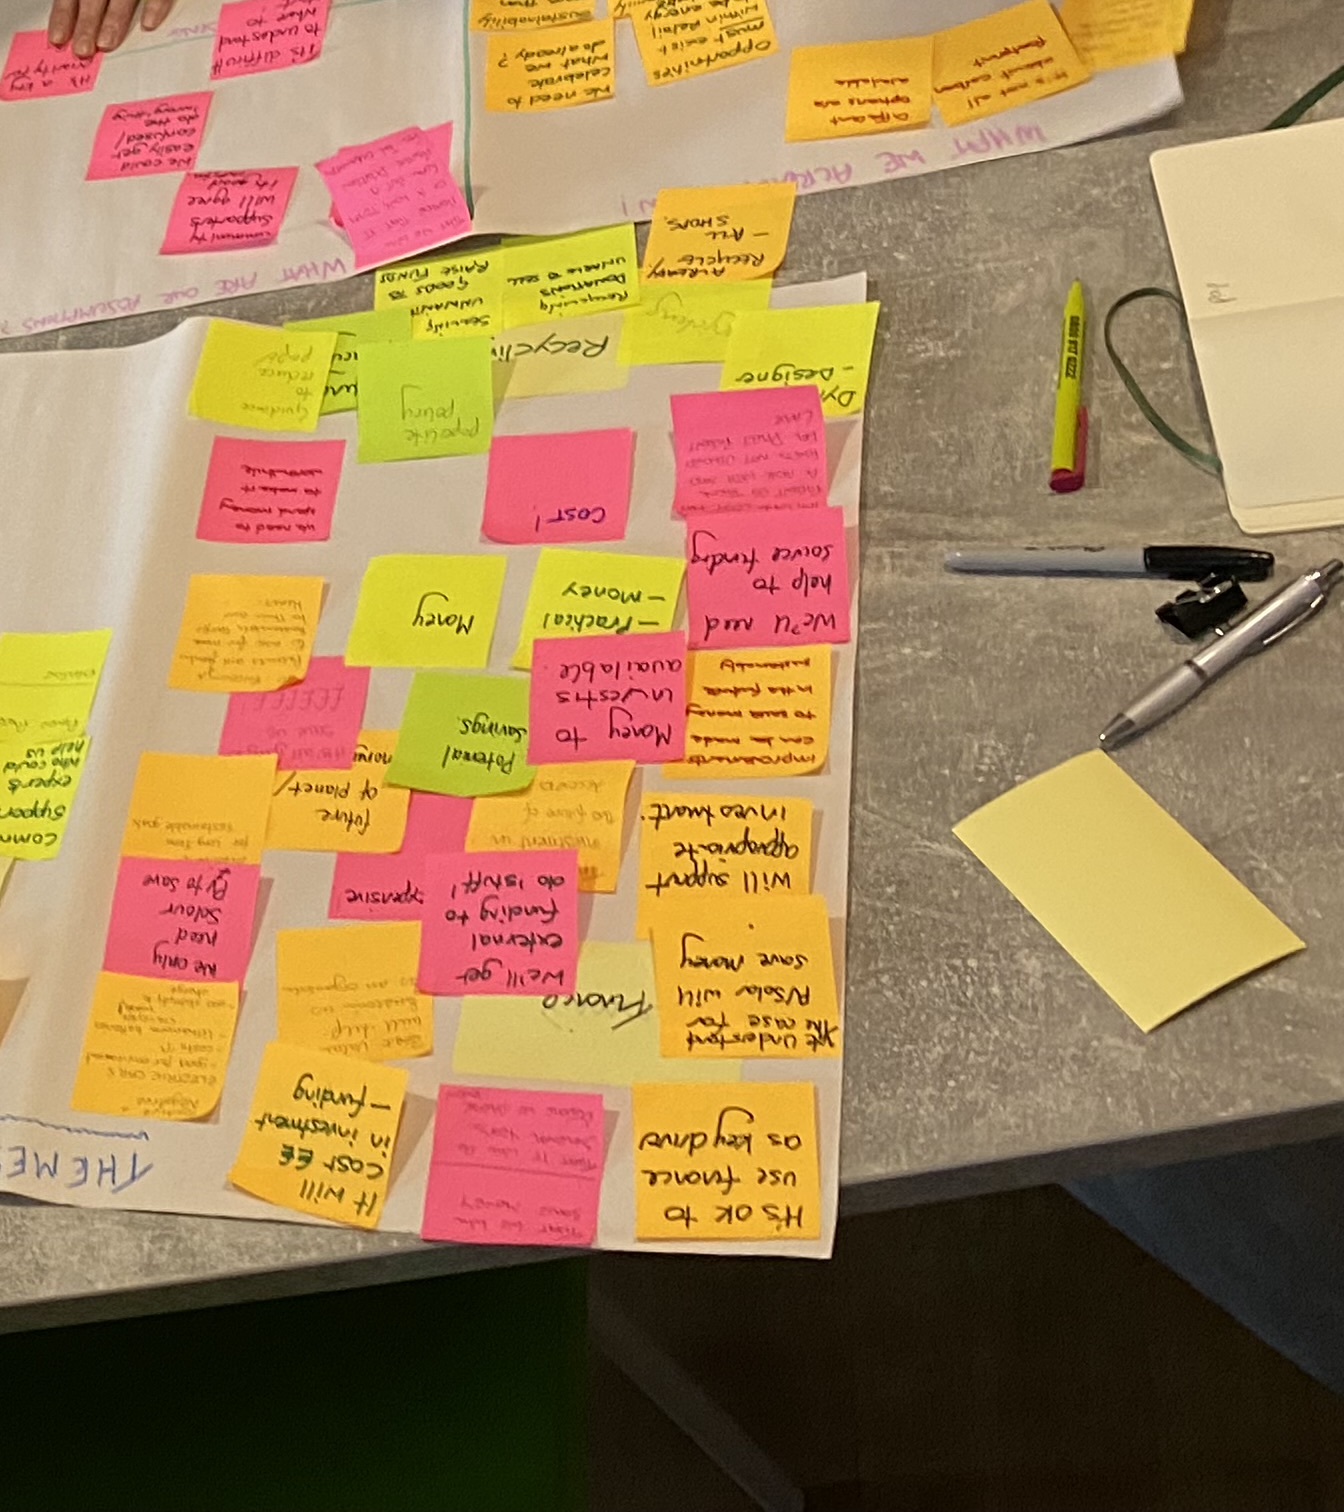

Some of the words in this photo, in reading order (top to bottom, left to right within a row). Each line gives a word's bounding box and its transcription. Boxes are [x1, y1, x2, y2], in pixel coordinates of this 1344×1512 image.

[246, 15, 267, 28] to
[275, 7, 318, 24] where
[706, 3, 759, 25] within
[302, 22, 321, 37] to
[717, 21, 765, 43] must
[658, 36, 709, 54] exist
[973, 36, 1046, 68] footprint
[211, 48, 280, 73] difficult
[524, 61, 551, 74] we
[559, 53, 610, 70] what
[1000, 57, 1053, 79] about
[9, 77, 33, 92] key
[528, 67, 611, 89] celebrate
[934, 74, 991, 94] carbon
[529, 90, 578, 107] need
[584, 84, 611, 98] We
[1000, 82, 1028, 97] not
[506, 95, 522, 109] to
[813, 100, 840, 108] are
[848, 95, 910, 106] options
[968, 94, 991, 109] all
[144, 118, 170, 127] the
[111, 143, 148, 159] get
[150, 143, 194, 157] easily
[948, 123, 1044, 162] WHAT
[120, 159, 162, 171] could
[172, 157, 192, 168] We
[875, 149, 924, 173] WE
[187, 188, 230, 206] agree
[239, 195, 275, 208] will
[705, 228, 744, 241] ALL
[440, 260, 489, 275] RAISE
[677, 252, 765, 267] RECYCLE
[279, 256, 345, 285] WHAT
[380, 267, 429, 285] FUNDS
[215, 271, 257, 297] ARE
[160, 286, 198, 304] OUR
[735, 365, 834, 384] Designer
[295, 386, 312, 399] to
[219, 499, 272, 516] money
[278, 505, 316, 517] spend
[234, 523, 250, 533] to
[254, 523, 292, 535] need
[687, 530, 760, 574] funding
[771, 545, 834, 562] source
[753, 577, 780, 595] to
[791, 568, 832, 596] help
[413, 592, 475, 634] Money
[704, 617, 753, 640] need
[559, 658, 682, 680] available
[794, 710, 816, 720] to
[607, 707, 672, 746] Money
[50, 740, 84, 756] help
[556, 728, 585, 750] to
[779, 736, 814, 745] can
[2, 758, 46, 774] could
[51, 757, 80, 771] who
[358, 780, 378, 799] of
[314, 808, 370, 836] future
[673, 826, 799, 862] appropriate
[187, 876, 202, 894] to
[537, 875, 565, 890] do
[645, 860, 730, 897] support
[445, 909, 469, 925] to
[479, 895, 559, 924] funding
[176, 927, 217, 948] need
[471, 932, 563, 953] external
[153, 941, 188, 970] only
[758, 953, 808, 970] save
[192, 958, 217, 977] We
[455, 958, 502, 984] get
[508, 969, 564, 987] We'll
[677, 985, 721, 1006] will
[686, 1012, 729, 1030] for
[748, 1015, 795, 1028] case
[292, 1072, 367, 1118] funding
[254, 1111, 358, 1146] investment
[713, 1107, 754, 1155] key
[370, 1133, 391, 1156] in
[768, 1134, 802, 1150] as
[641, 1167, 740, 1194] finance
[757, 1167, 797, 1187] use
[299, 1179, 346, 1204] will
[353, 1191, 379, 1217] It
[664, 1207, 696, 1229] to
[714, 1205, 752, 1225] ok
